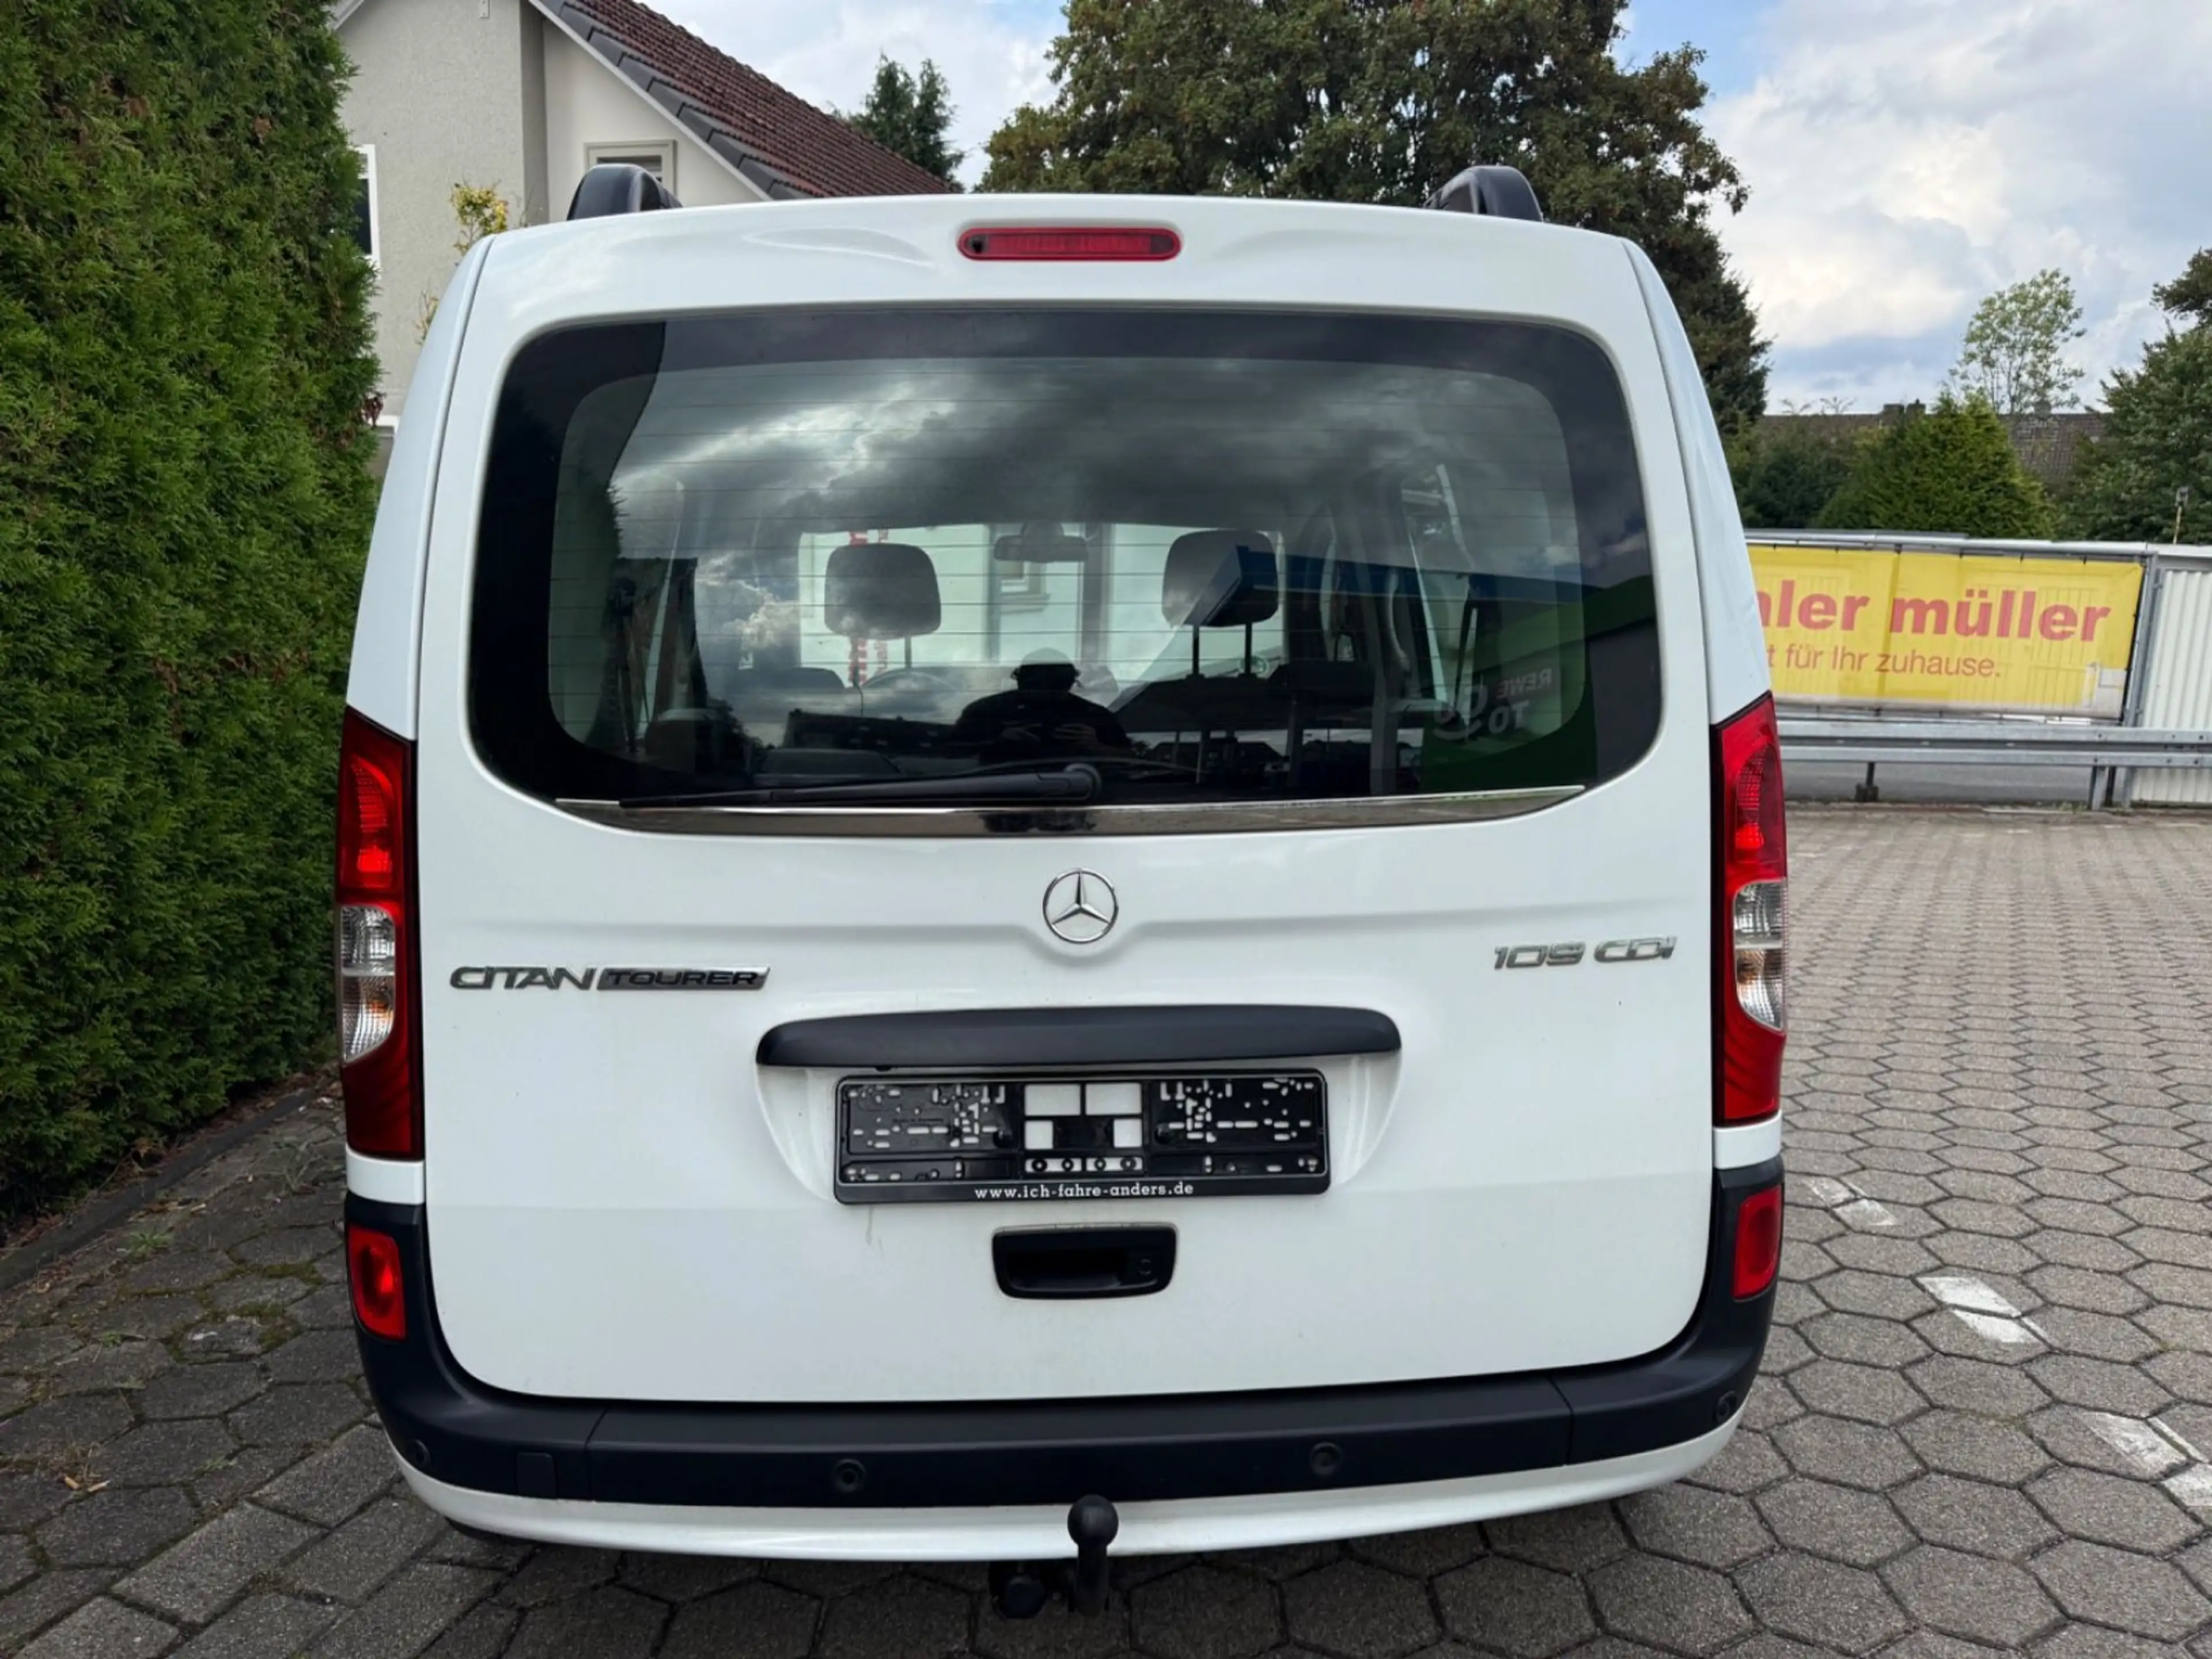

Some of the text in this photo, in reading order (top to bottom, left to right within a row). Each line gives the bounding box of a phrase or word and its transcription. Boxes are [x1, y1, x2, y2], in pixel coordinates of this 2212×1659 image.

[1889, 588, 2112, 642] müller
[1785, 642, 1824, 670] für
[1831, 645, 1869, 672] Ihr
[1874, 649, 2001, 678] zuhause.
[1494, 941, 1585, 970] 109
[450, 966, 759, 990] CITAN TOURER
[975, 1182, 1194, 1199] www.ich-fahre-anders.de
